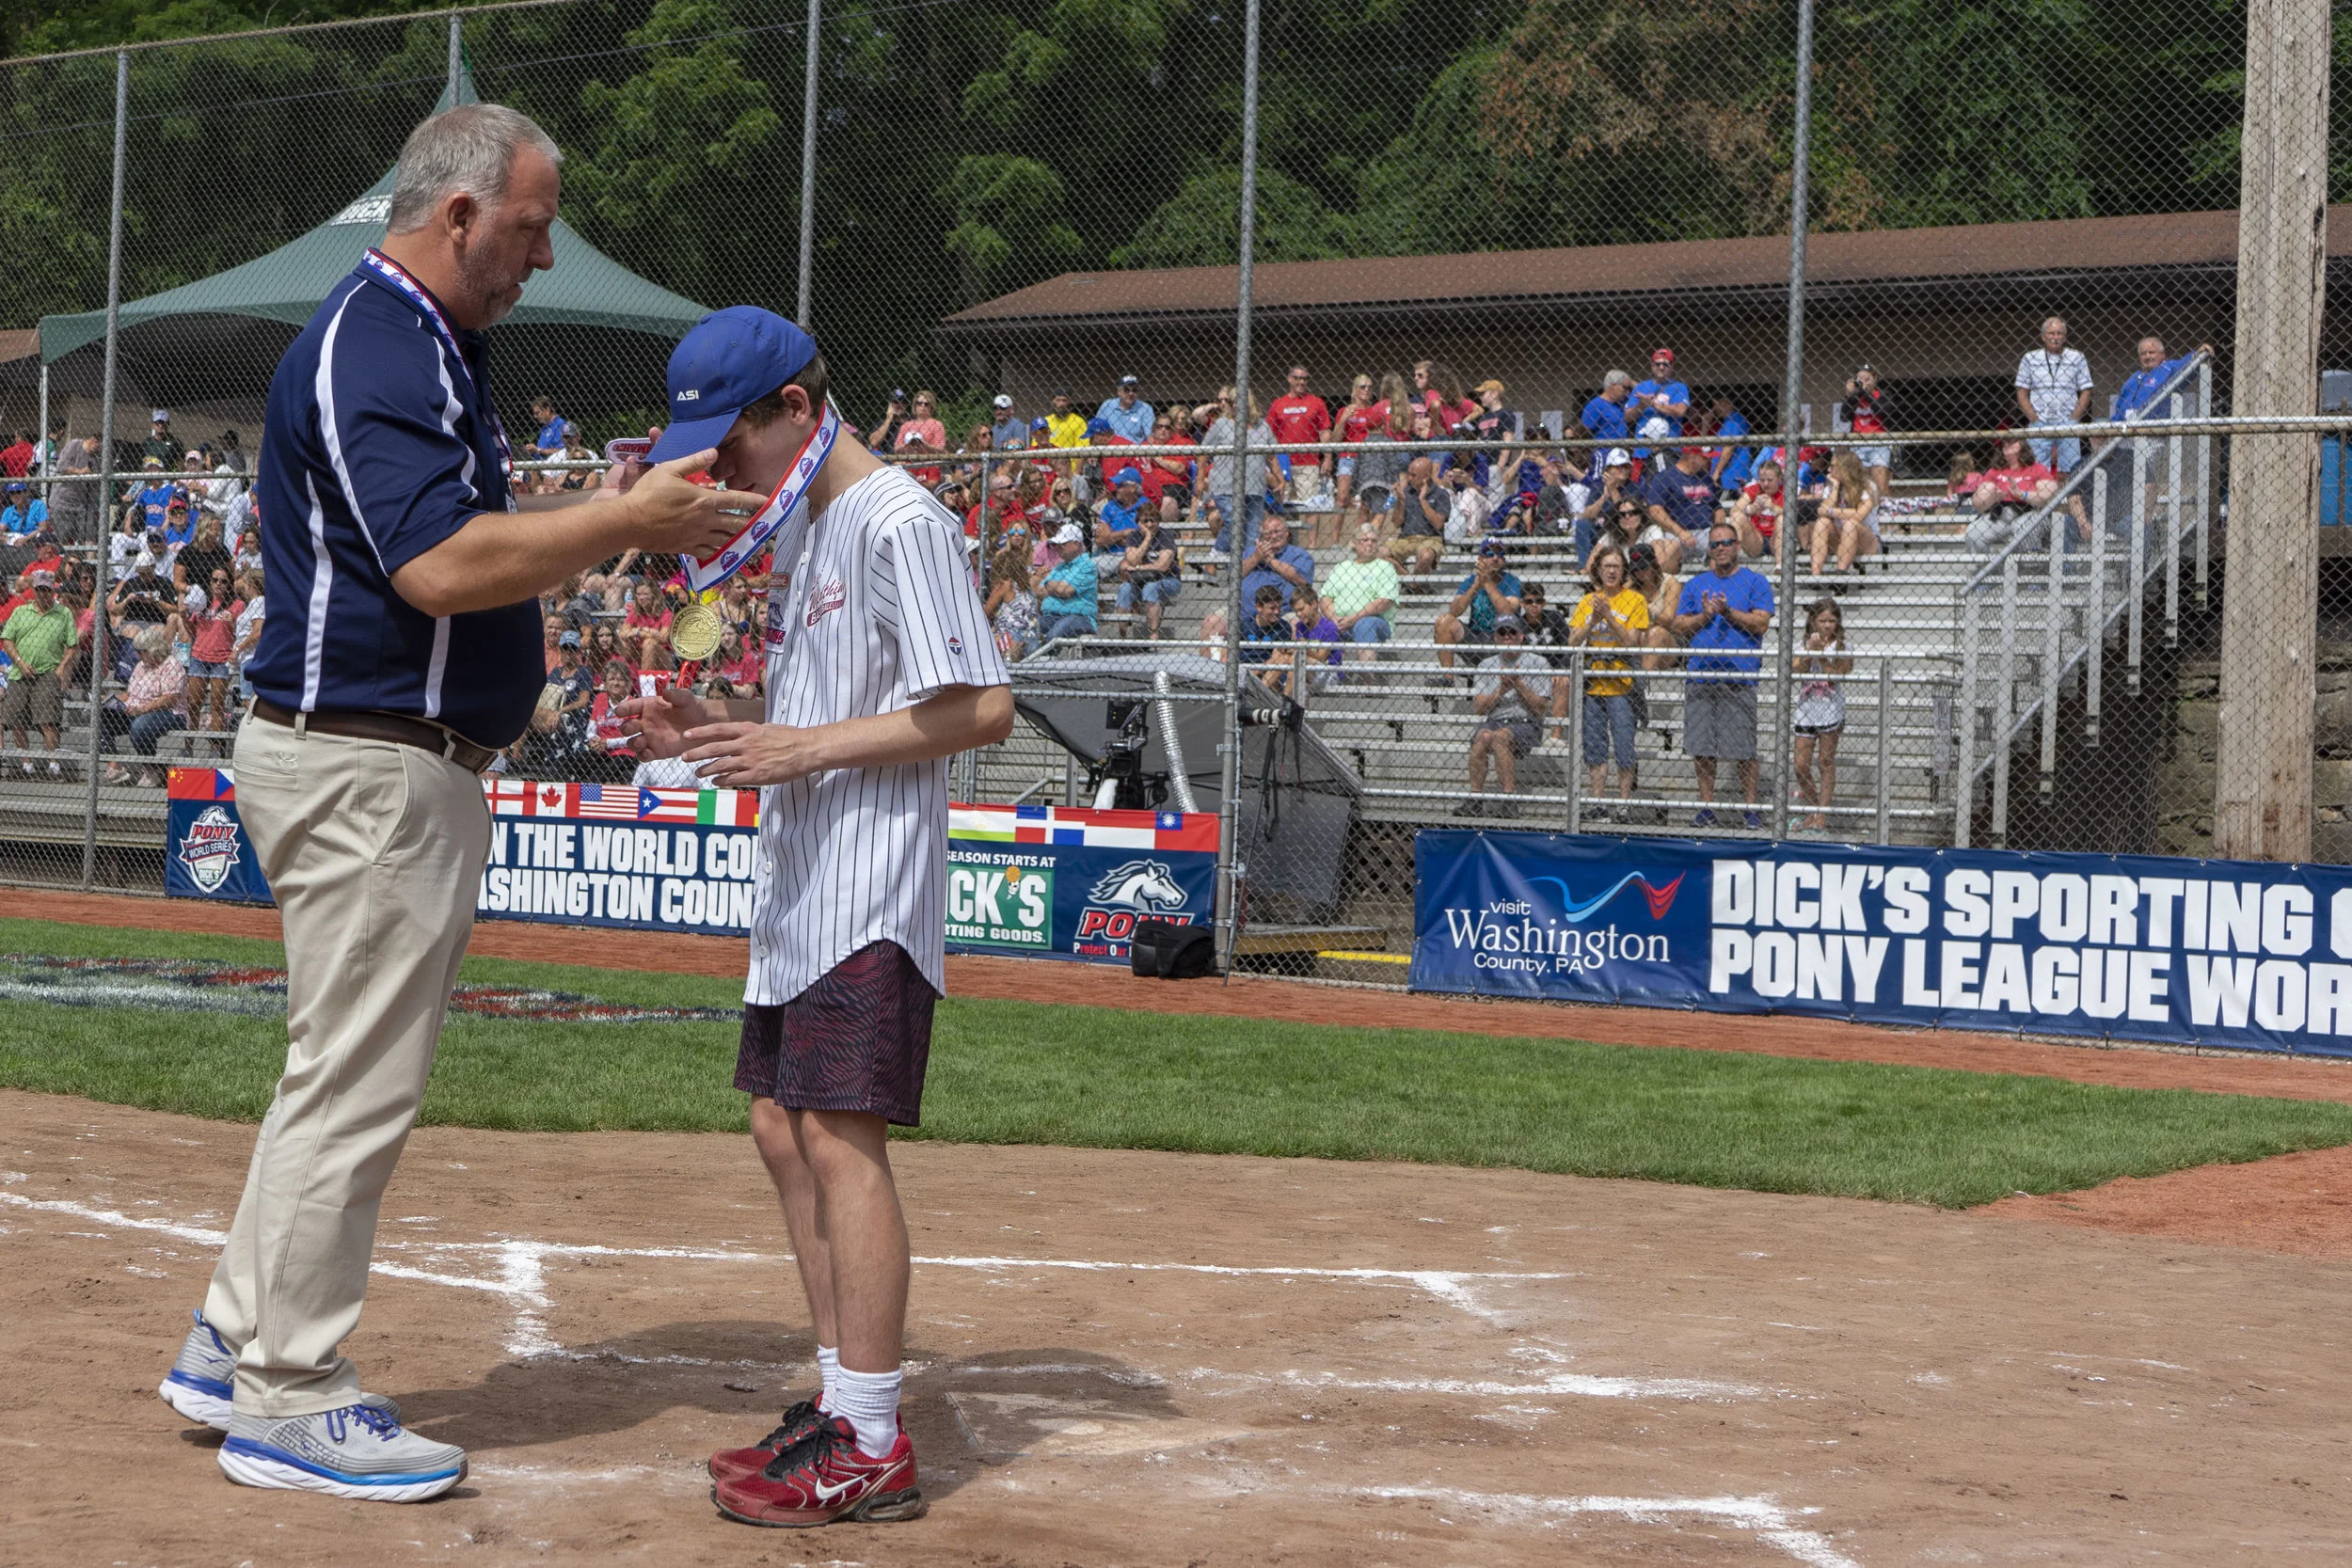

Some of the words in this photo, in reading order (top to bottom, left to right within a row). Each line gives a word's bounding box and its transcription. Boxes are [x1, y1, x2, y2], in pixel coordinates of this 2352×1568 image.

[676, 389, 700, 402] ASI
[191, 824, 234, 840] PONY
[188, 844, 211, 859] WORLD
[210, 842, 233, 854] SERIES
[514, 822, 576, 869] THE
[581, 826, 699, 877] WORLD
[993, 854, 1038, 866] STARTS
[1040, 856, 1057, 868] AT
[660, 877, 755, 928] COUN
[945, 869, 1047, 928] CK'S
[1490, 898, 1532, 916] visit
[1711, 859, 1931, 934] DICK'S
[1943, 868, 2314, 957] SPORTING
[1444, 908, 1671, 970] Washington
[1073, 942, 1108, 956] Protect
[1109, 943, 1127, 957] Our
[1555, 958, 1584, 975] PA
[1708, 928, 1890, 1004] PONY
[1902, 939, 2171, 1022] LEAGUE
